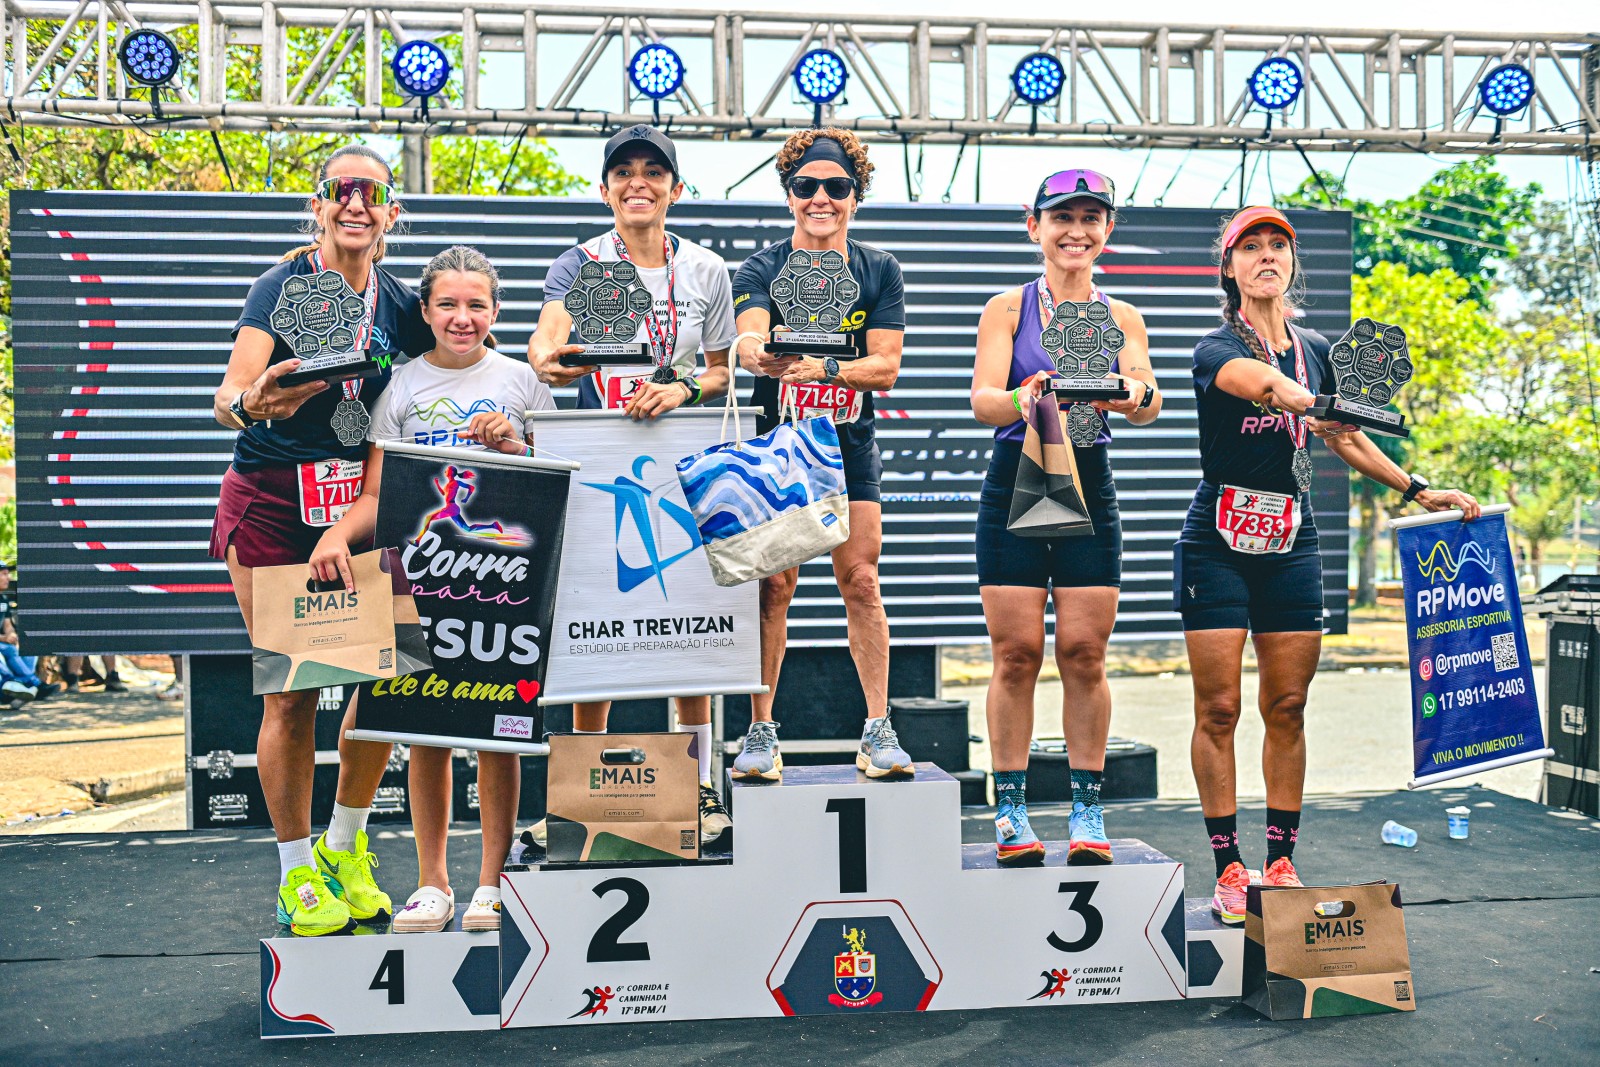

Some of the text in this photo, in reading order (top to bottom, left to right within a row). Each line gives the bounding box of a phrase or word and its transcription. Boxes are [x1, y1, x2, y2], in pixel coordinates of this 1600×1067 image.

[791, 386, 848, 406] 17146
[316, 480, 361, 505] 17114
[1225, 510, 1285, 536] 17333
[402, 530, 529, 582] Corra
[411, 584, 529, 605] para
[568, 616, 734, 639] CHAR TREVIZAN
[1416, 610, 1511, 640] ASSESSORIA ESPORTIVA
[570, 637, 734, 654] ESTÚDIO DE PREPARAÇÃO FÍSICA
[1435, 648, 1492, 676] @rpmove
[421, 674, 448, 698] te
[452, 681, 516, 702] ama
[1438, 678, 1525, 711] 17 99114-2403
[1432, 734, 1523, 765] VIVA O MOVIMENTO !!
[825, 798, 867, 893] 1
[587, 877, 650, 962] 2
[1046, 881, 1103, 952] 3
[368, 950, 404, 1004] 4
[619, 994, 667, 1002] CAMINHADA
